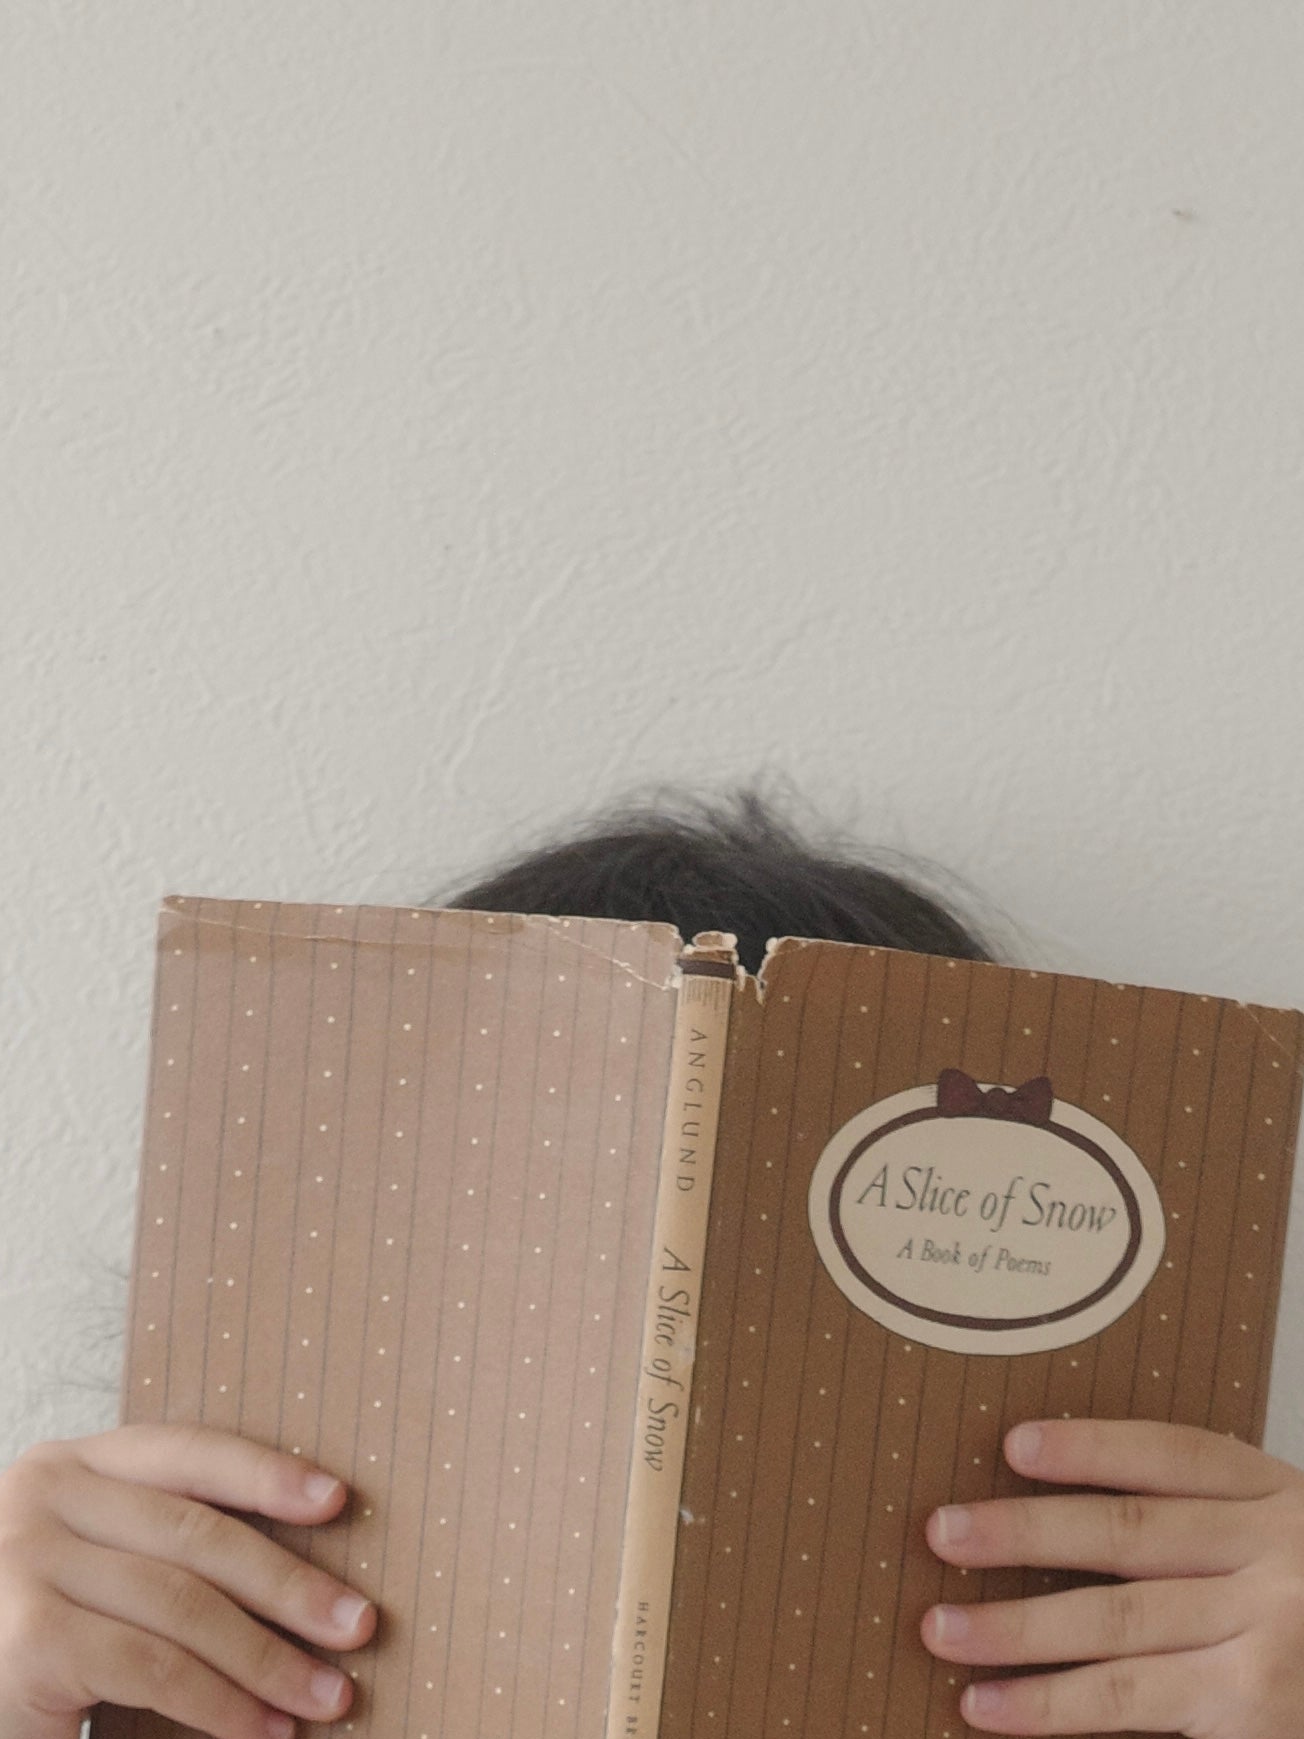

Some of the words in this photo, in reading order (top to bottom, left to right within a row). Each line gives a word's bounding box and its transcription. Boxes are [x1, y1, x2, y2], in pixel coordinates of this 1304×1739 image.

[676, 1027, 708, 1192] ANGLUND
[856, 1163, 889, 1208] A
[895, 1166, 971, 1217] Slice
[980, 1176, 1024, 1233] of
[1022, 1182, 1117, 1233] Snow
[662, 1247, 692, 1272] A
[896, 1237, 914, 1260] A
[920, 1239, 961, 1266] Book
[968, 1245, 993, 1274] of
[995, 1248, 1052, 1277] Poems
[655, 1285, 692, 1347] Slice
[644, 1358, 685, 1393] of
[643, 1398, 680, 1473] Snow
[628, 1601, 649, 1704] HARCOURT
